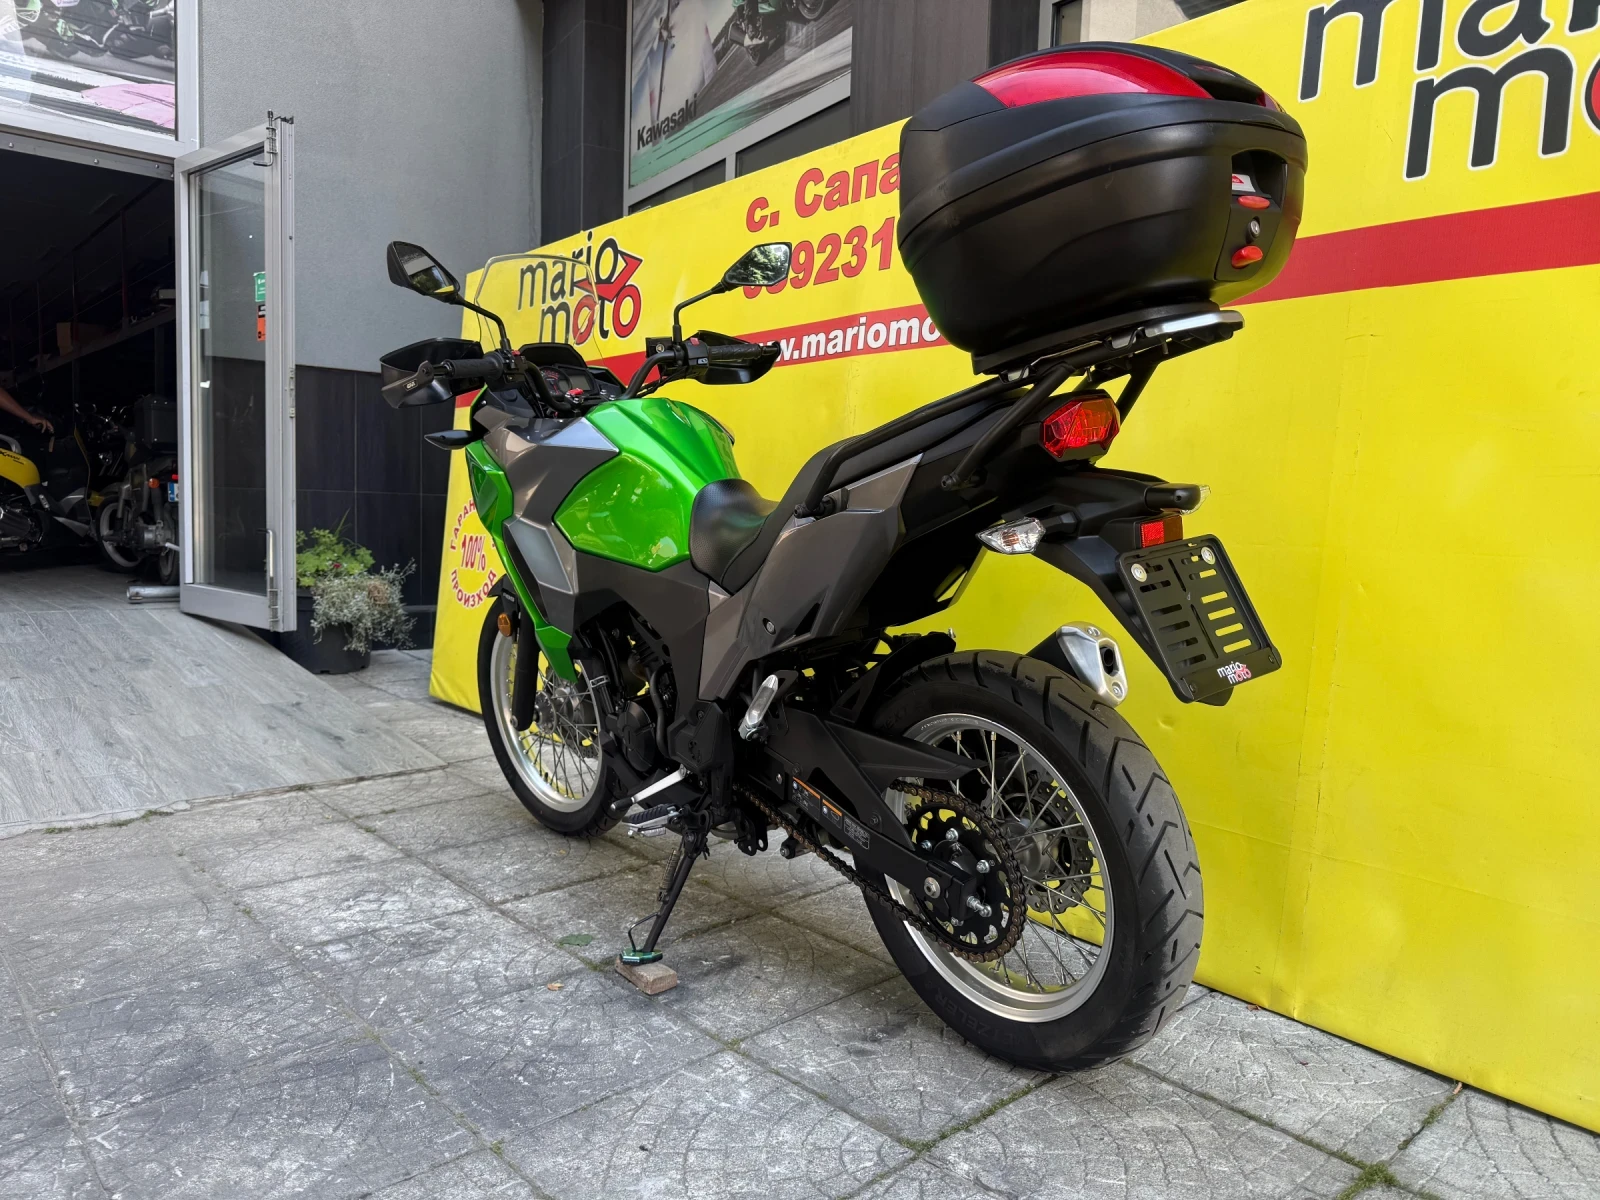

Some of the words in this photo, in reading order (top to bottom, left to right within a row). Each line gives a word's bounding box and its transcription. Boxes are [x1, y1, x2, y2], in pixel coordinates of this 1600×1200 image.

[1298, 0, 1600, 102] ma
[637, 94, 698, 150] Kawasaki
[1403, 46, 1600, 181] m
[518, 231, 619, 310] mario
[540, 284, 641, 345] moto
[461, 534, 486, 572] 100%
[451, 569, 497, 608] ПРОИЗХОД
[1217, 661, 1243, 678] mario
[1228, 667, 1252, 684] moto
